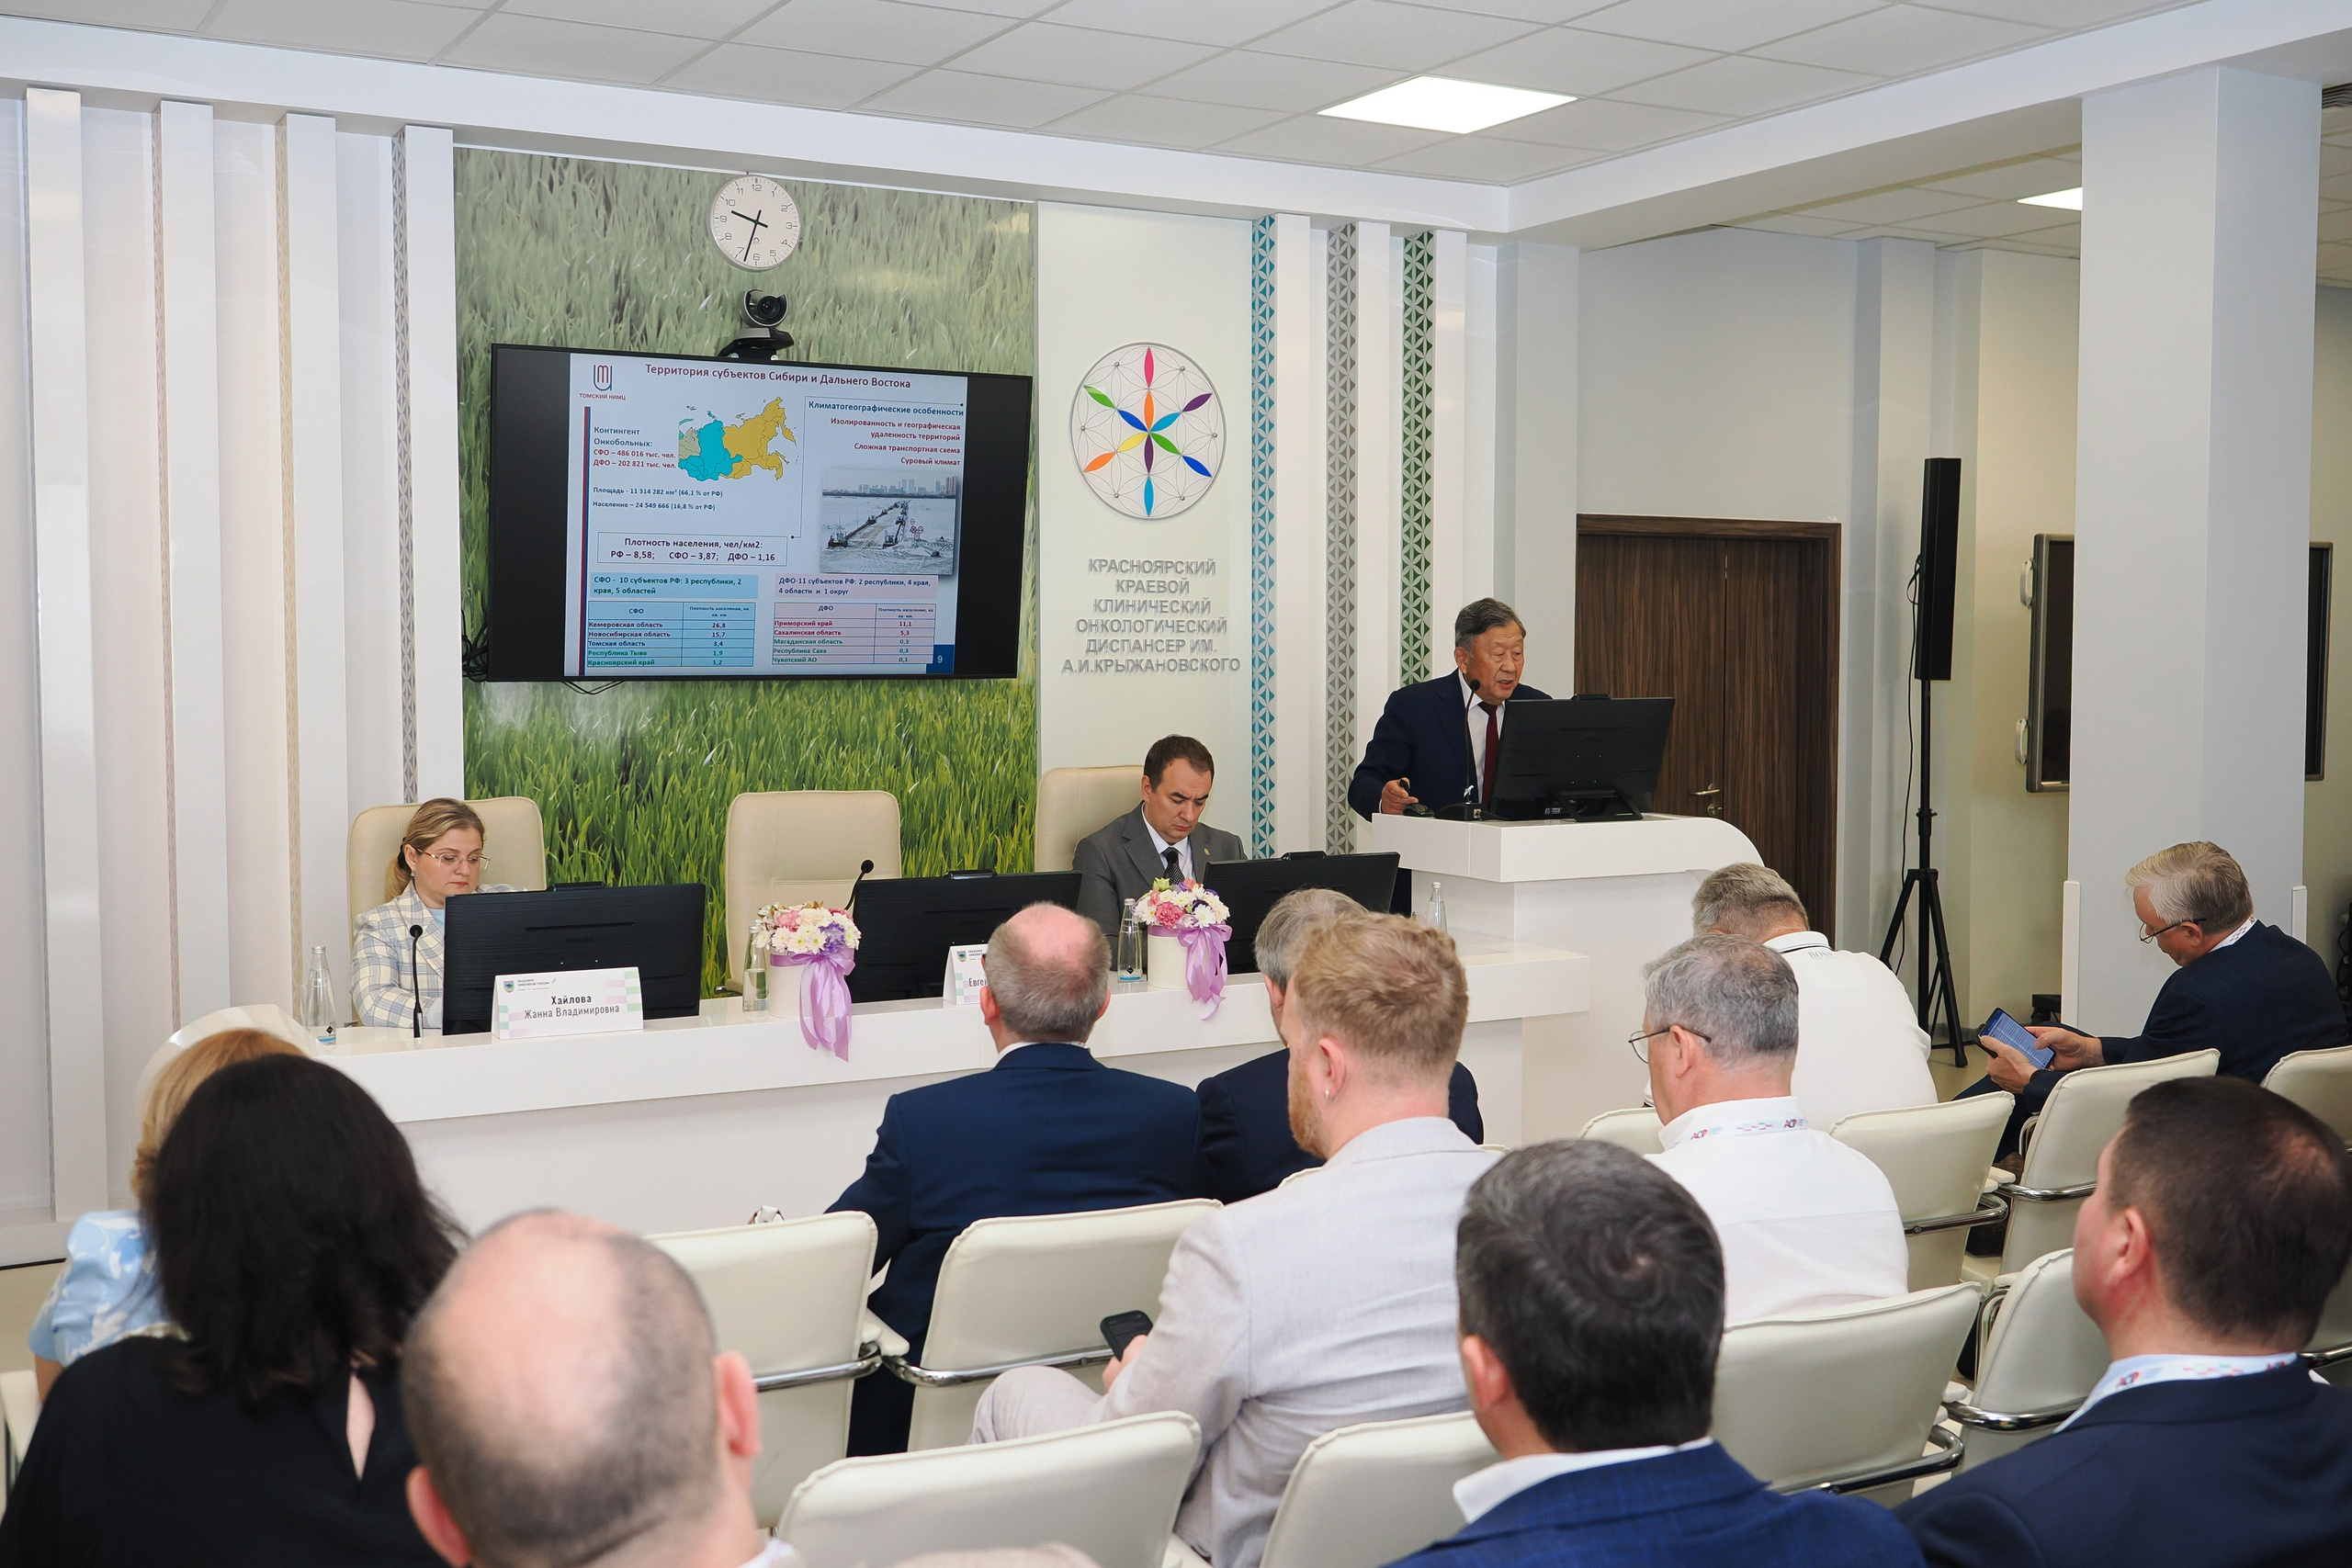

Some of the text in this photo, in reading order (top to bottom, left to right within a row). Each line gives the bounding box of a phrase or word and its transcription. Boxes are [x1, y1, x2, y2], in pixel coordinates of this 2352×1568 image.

[646, 364, 708, 378] Территория
[712, 367, 765, 380] субъектов
[769, 370, 808, 385] Сибири
[820, 375, 869, 387] Дальнего
[871, 377, 910, 389] Востока
[808, 401, 964, 416] Климатогеографические особенности
[831, 418, 896, 427] Изолированность
[594, 427, 639, 435] Контингент
[871, 432, 916, 440] удаленность
[594, 438, 652, 447] Онкобольных:
[594, 459, 610, 468] ДФО
[901, 457, 933, 466] Суровый
[625, 538, 763, 548] Плотность населения, чел/км2:
[634, 551, 655, 559] 8,58;
[698, 552, 718, 560] 3,87;
[728, 553, 748, 561] ДФО
[1089, 558, 1216, 574] КРАСНОЯРСКИЙ
[1115, 577, 1190, 593] КРАЕВОЙ
[1093, 597, 1211, 614] КЛИНИЧЕСКИЙ
[1076, 616, 1227, 633] ОНКОЛОГИЧЕСКИЙ
[1085, 639, 1217, 654] ДИСПАНСЕР ИМ.
[1062, 658, 1240, 672] А.И.КРЫЖАНОВСКОГО
[551, 995, 592, 1005] Хайлова
[525, 1006, 620, 1019] Жанна Владимировна
